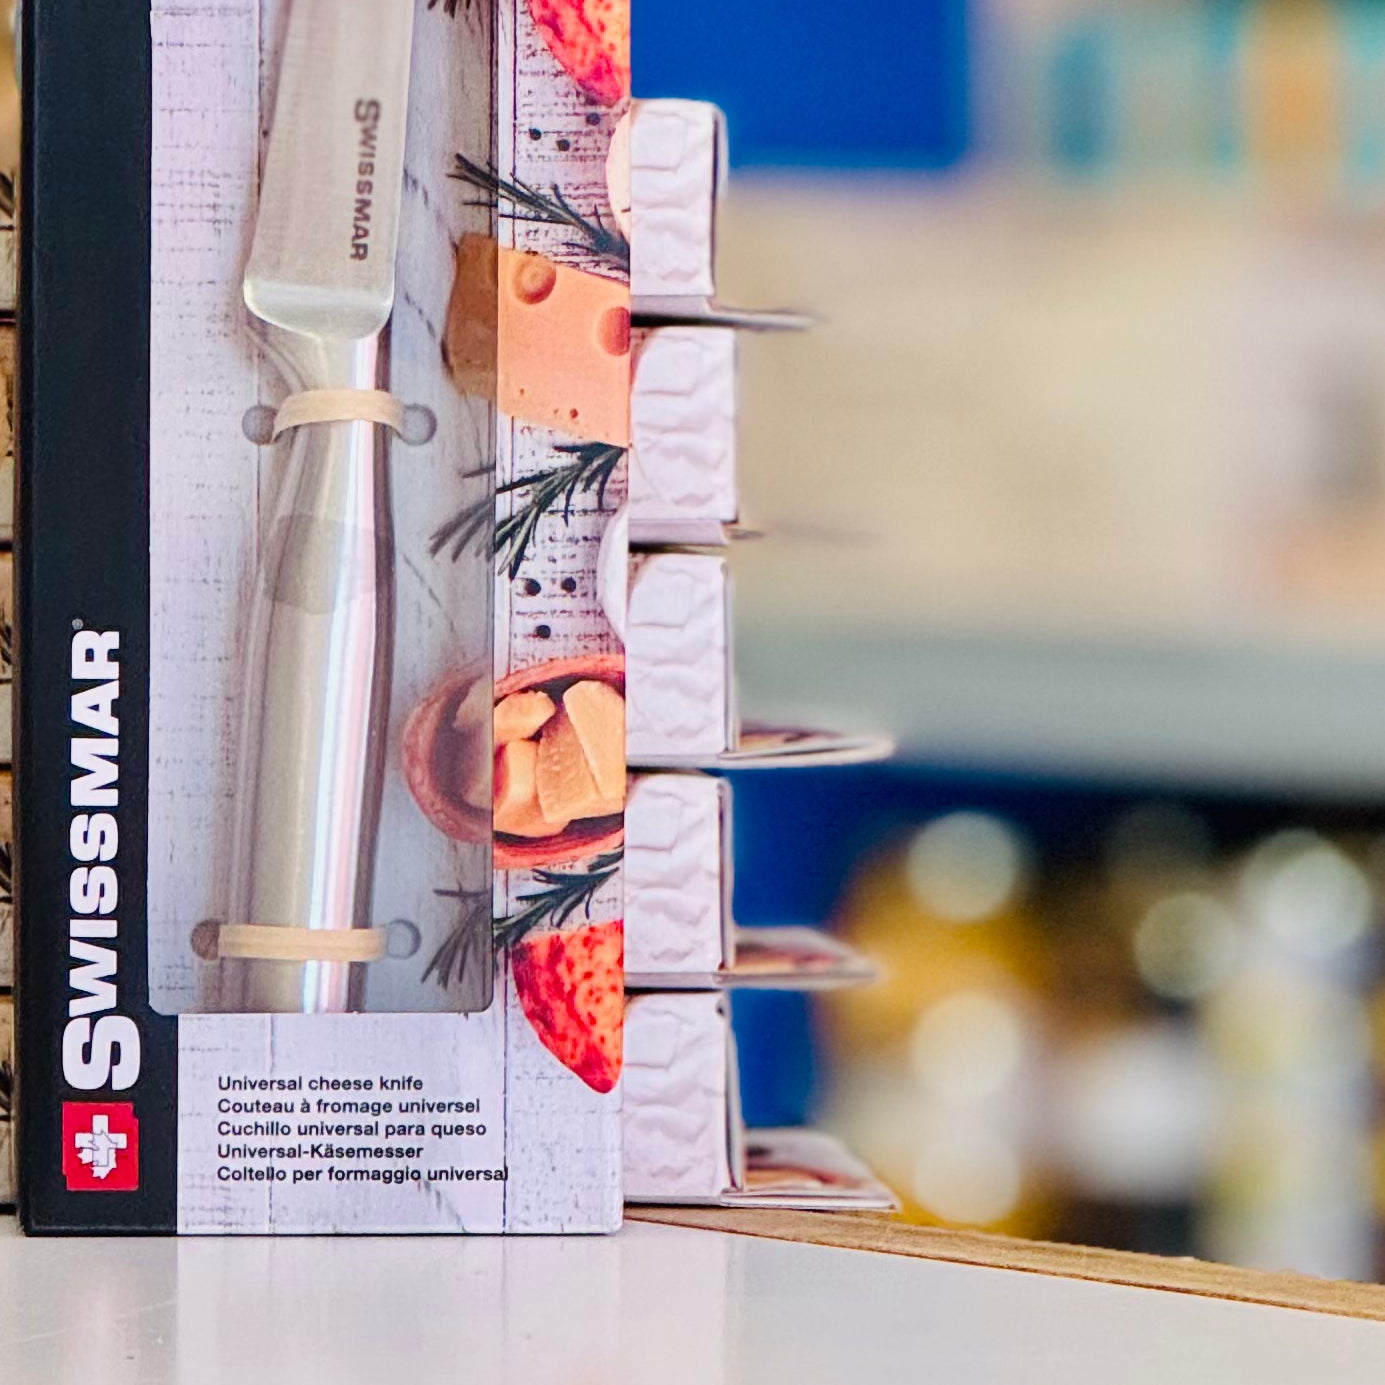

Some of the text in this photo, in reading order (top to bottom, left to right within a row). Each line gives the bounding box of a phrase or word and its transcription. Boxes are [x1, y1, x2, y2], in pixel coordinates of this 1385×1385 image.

[350, 98, 382, 262] SWISSMAR
[62, 630, 141, 1091] SWISSMAR
[218, 1075, 424, 1091] Universal cheese knife
[217, 1097, 481, 1117] Couteau à fromage universel
[217, 1120, 487, 1139] Cuchillo universal para queso
[217, 1142, 424, 1159] Universal-Käsemesser
[217, 1165, 509, 1185] Coltello per formaggio universal
